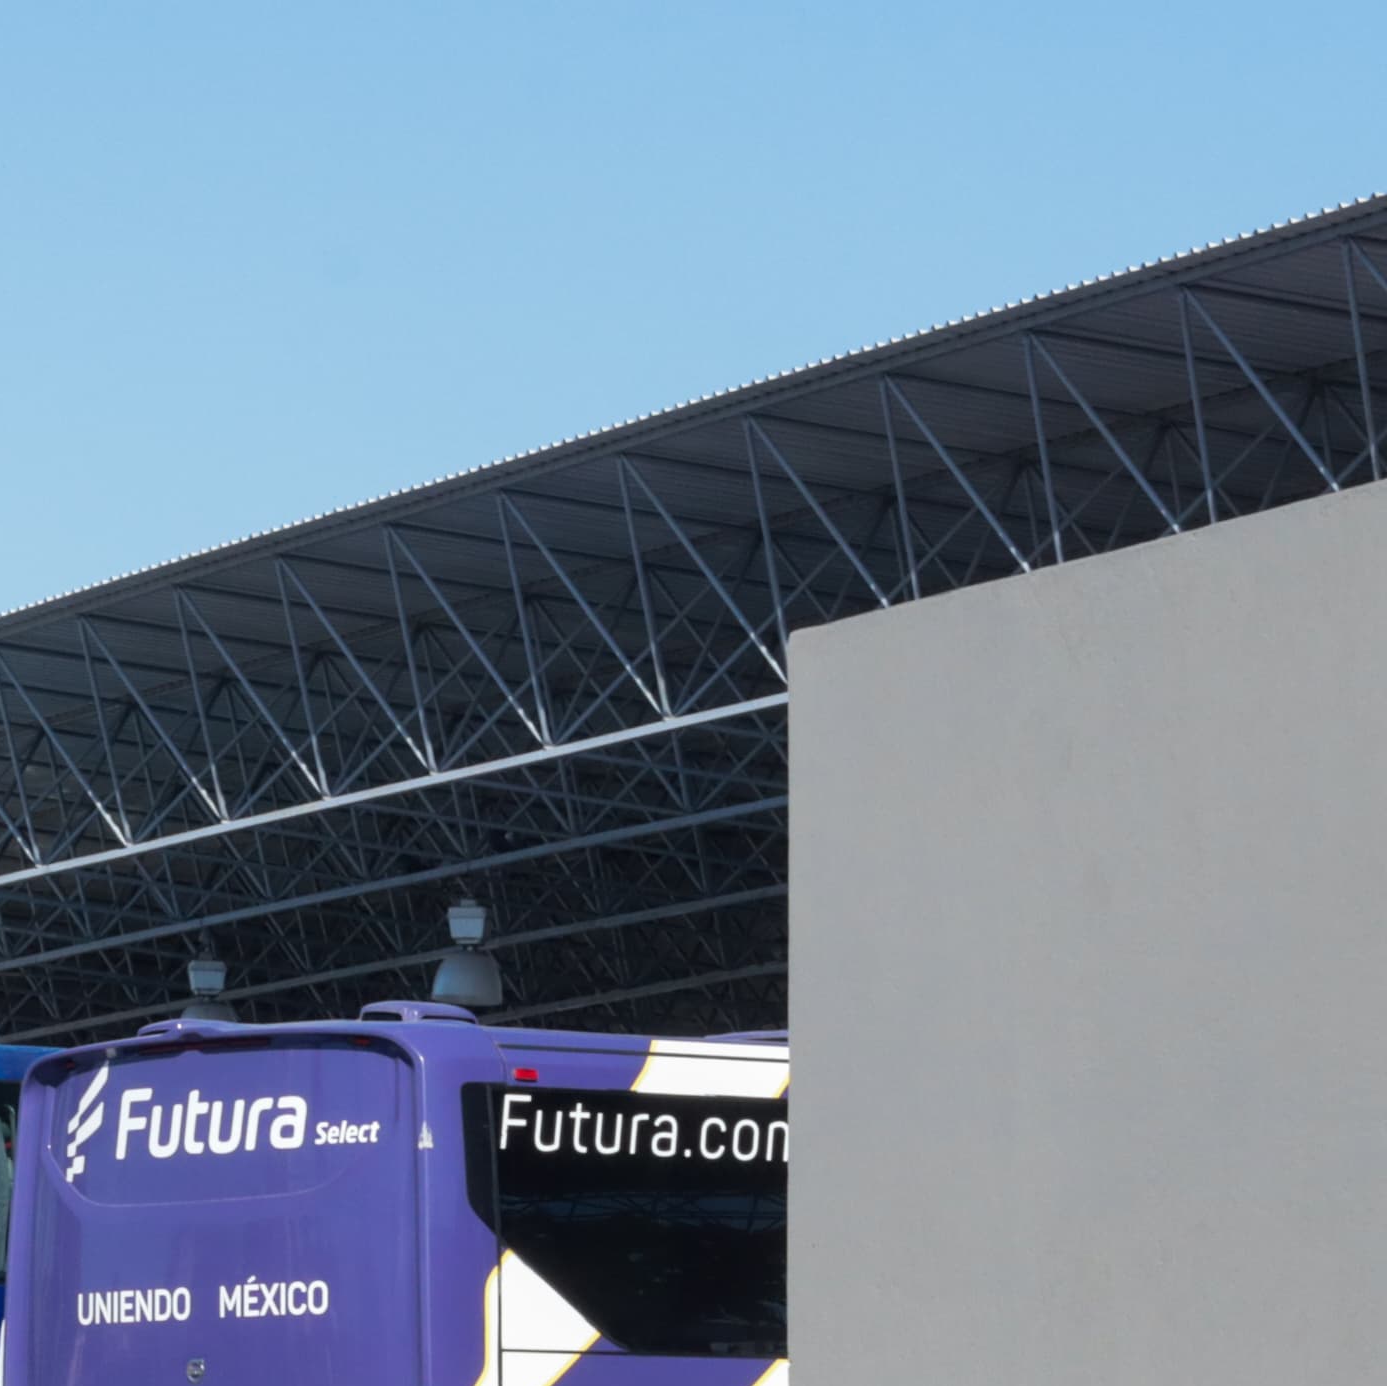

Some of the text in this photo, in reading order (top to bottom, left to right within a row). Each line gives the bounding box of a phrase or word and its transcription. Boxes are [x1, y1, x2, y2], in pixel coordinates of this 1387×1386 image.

[115, 1087, 380, 1161] Futura Select
[77, 1275, 329, 1326] UNIENDO MÉXICO
